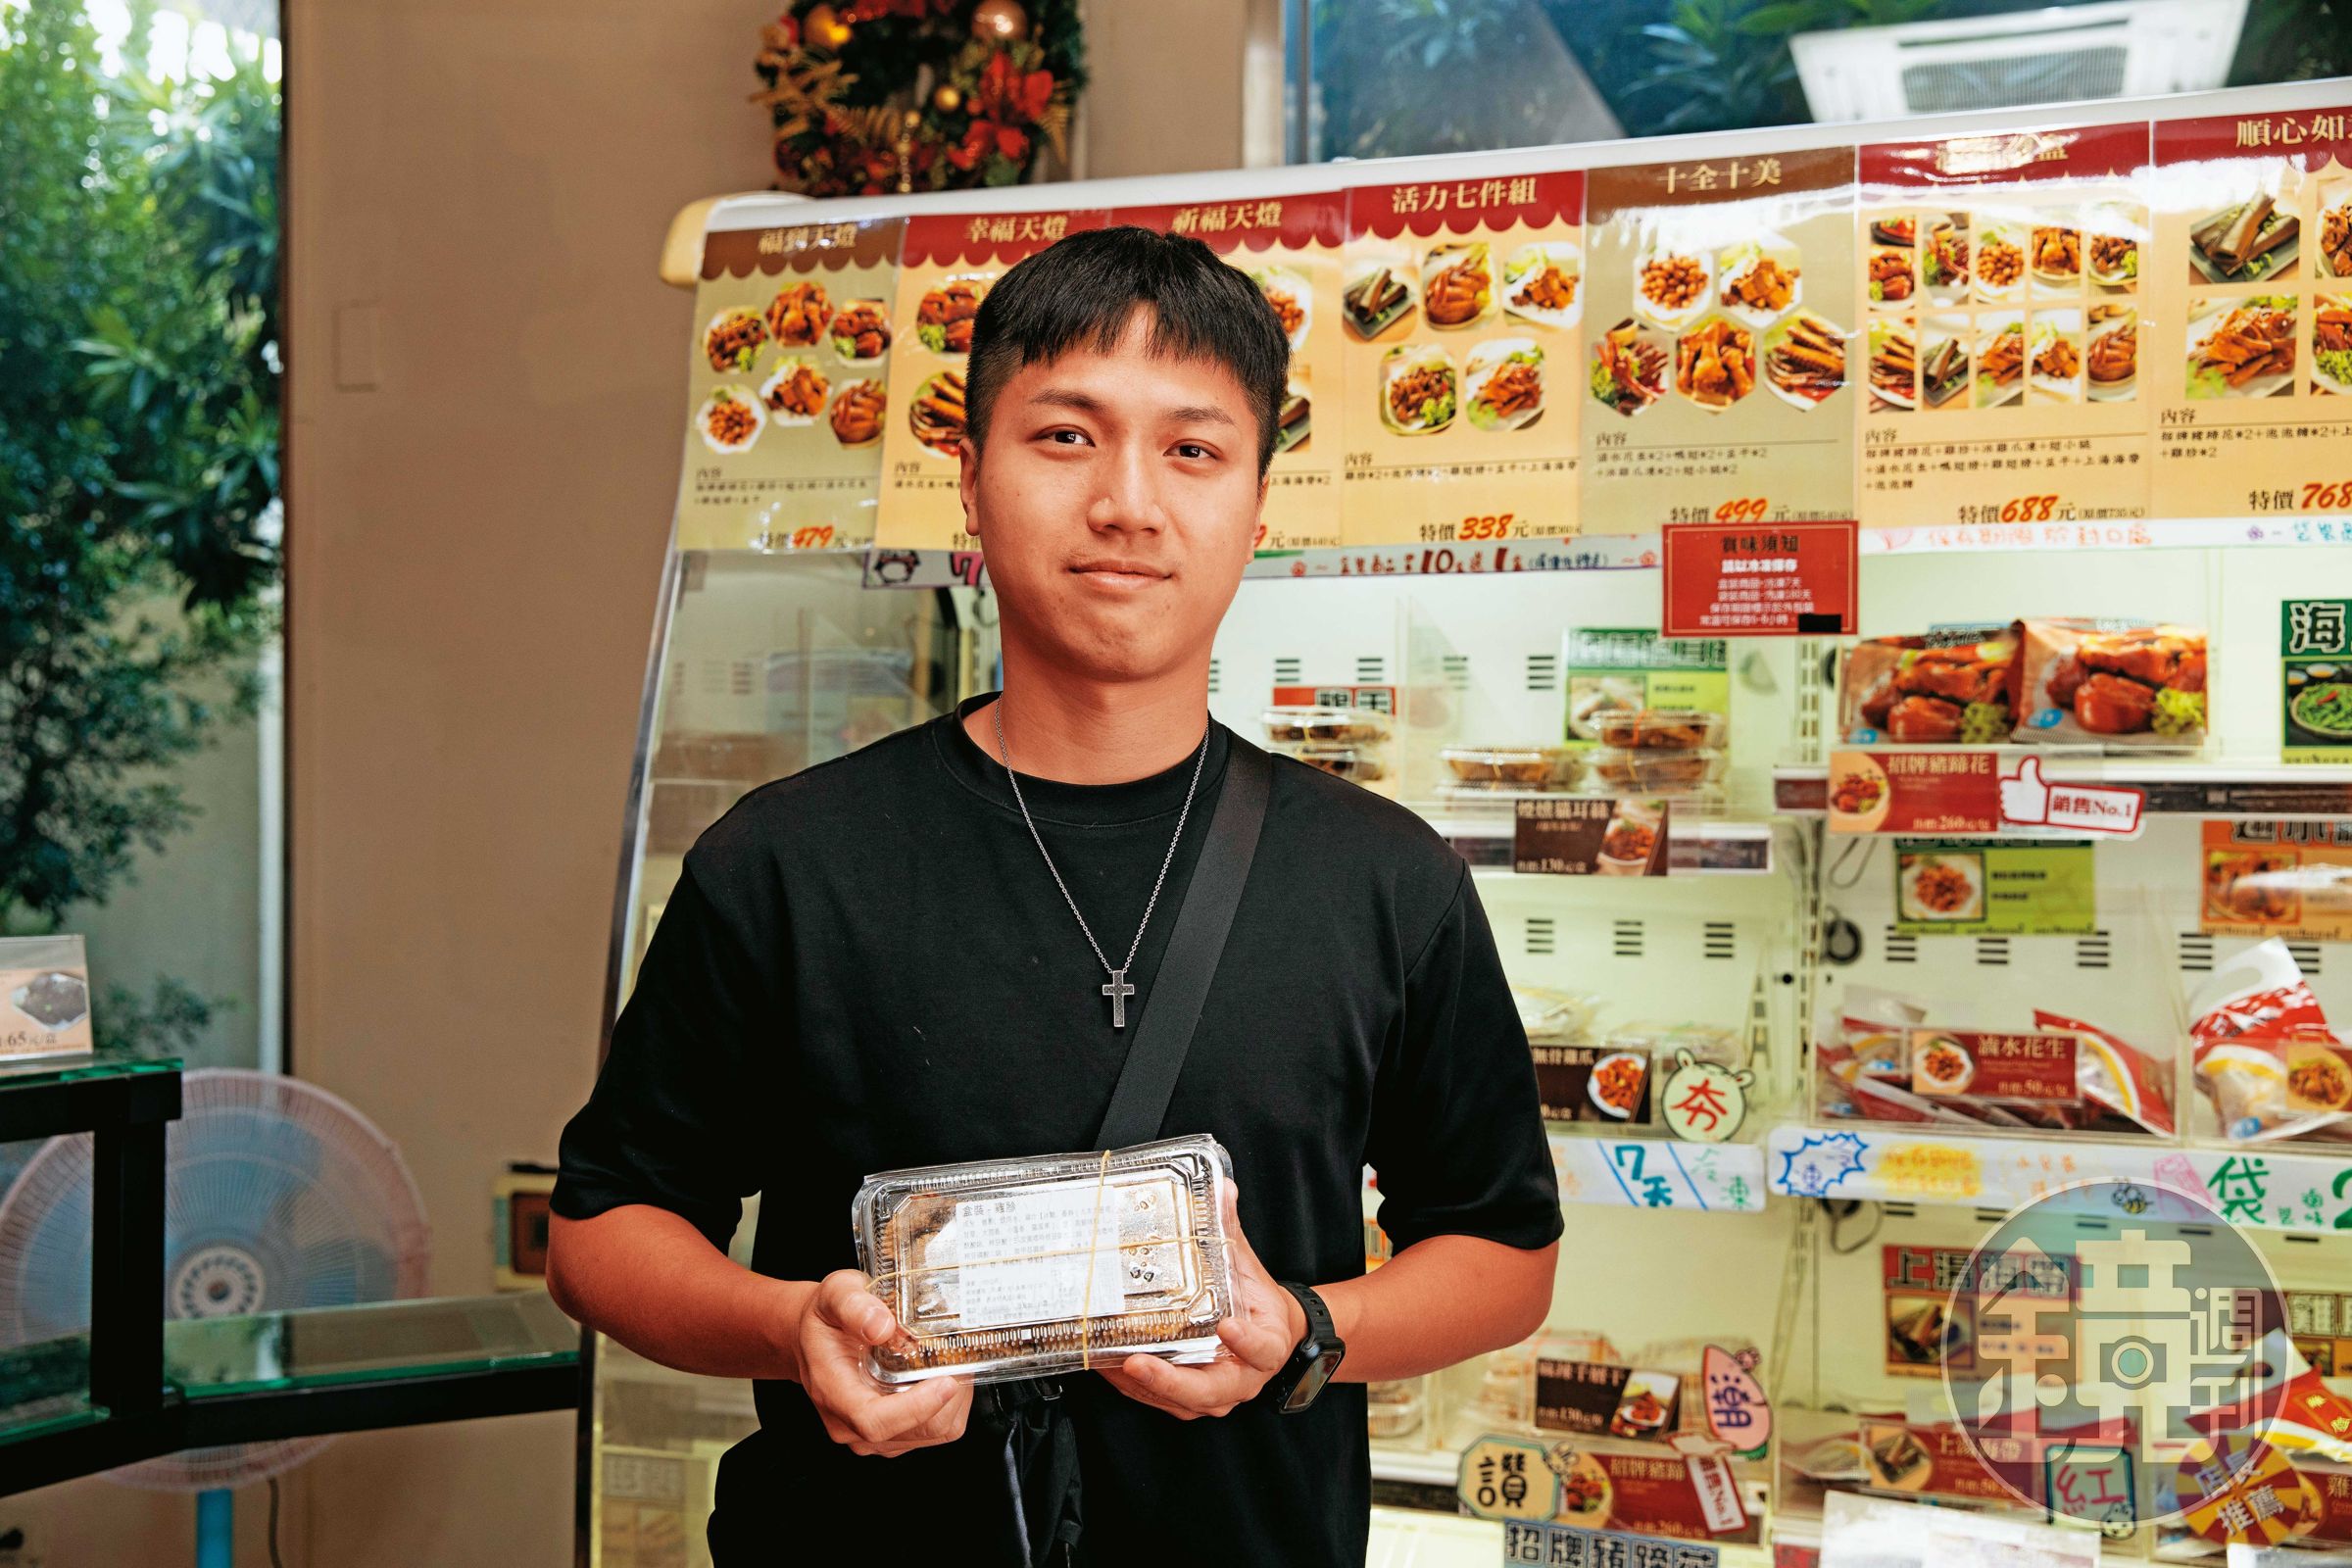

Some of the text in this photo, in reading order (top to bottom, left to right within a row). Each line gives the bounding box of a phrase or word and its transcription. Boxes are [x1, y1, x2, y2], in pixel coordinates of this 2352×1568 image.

[2235, 113, 2352, 149] 順心如
[1656, 159, 1782, 192] 十全十美
[1392, 177, 1538, 214] 活力七件組
[968, 215, 1068, 243] 幸福天燈
[1172, 201, 1282, 233] 祈福天燈
[2161, 408, 2195, 423] 內容
[1670, 507, 1710, 523] 特價
[1715, 498, 1768, 523] 499
[1959, 504, 1999, 524] 特價
[2001, 495, 2058, 522] 688
[2249, 481, 2352, 511] 特價 768
[1420, 522, 1454, 541] 特價
[1458, 514, 1514, 540] 338
